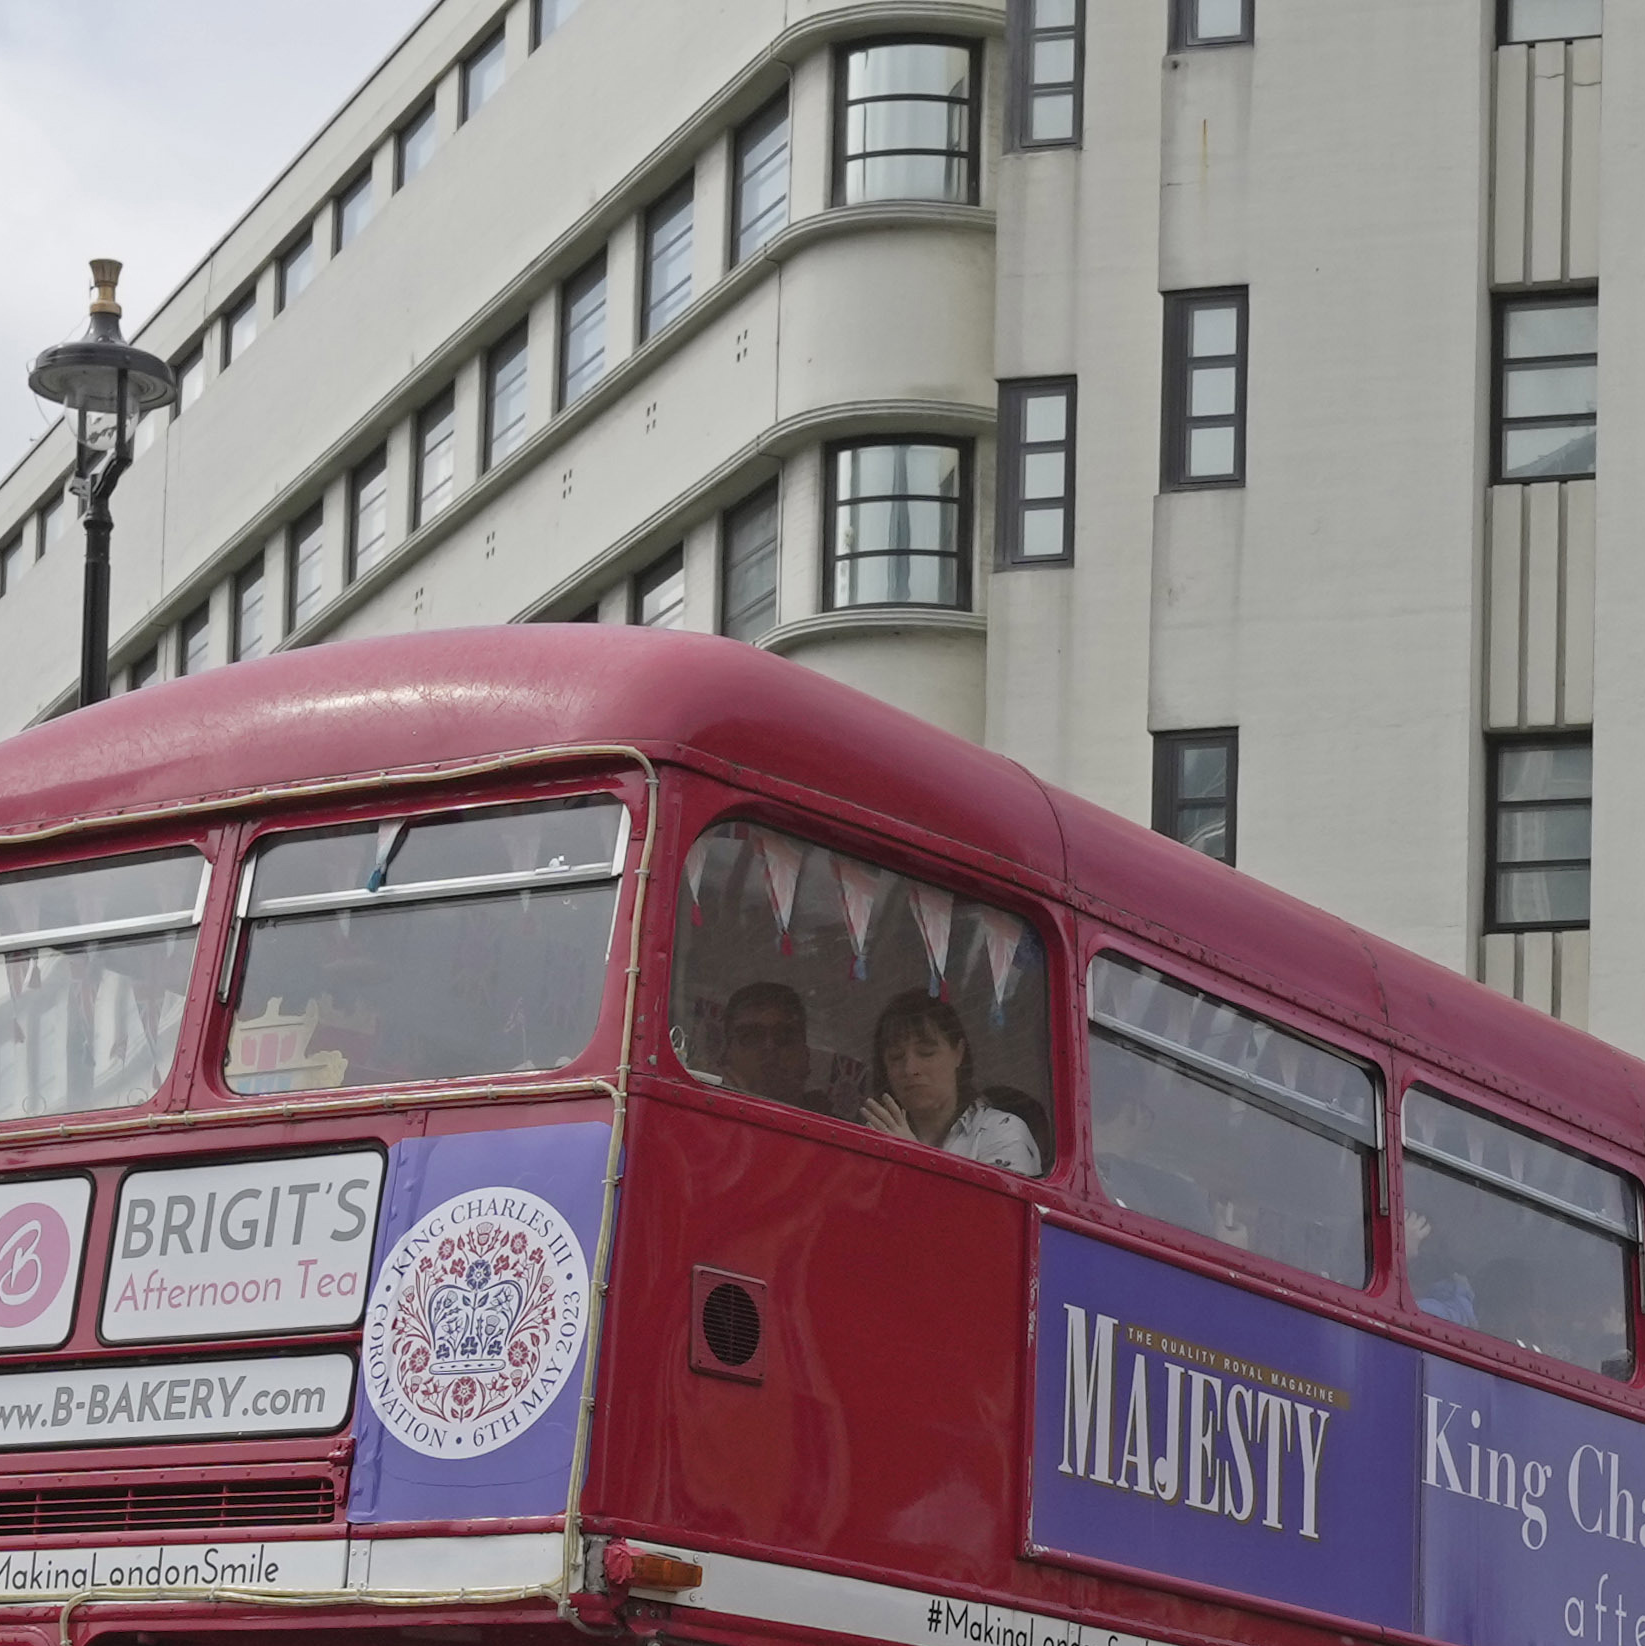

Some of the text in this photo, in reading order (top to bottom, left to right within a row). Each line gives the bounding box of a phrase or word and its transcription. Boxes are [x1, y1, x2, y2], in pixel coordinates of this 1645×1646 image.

[121, 1178, 370, 1260] BRIGIT'S
[391, 1198, 574, 1278] KING CHARLES III
[114, 1259, 359, 1313] Afternoon Tea
[370, 1303, 448, 1449] CORONATION
[473, 1290, 581, 1448] 6TH MAY 2023
[1057, 1303, 1331, 1539] MAJESTY
[1128, 1327, 1335, 1403] THE QUALITY ROYAL MAGAZINE
[1422, 1393, 1553, 1551] King
